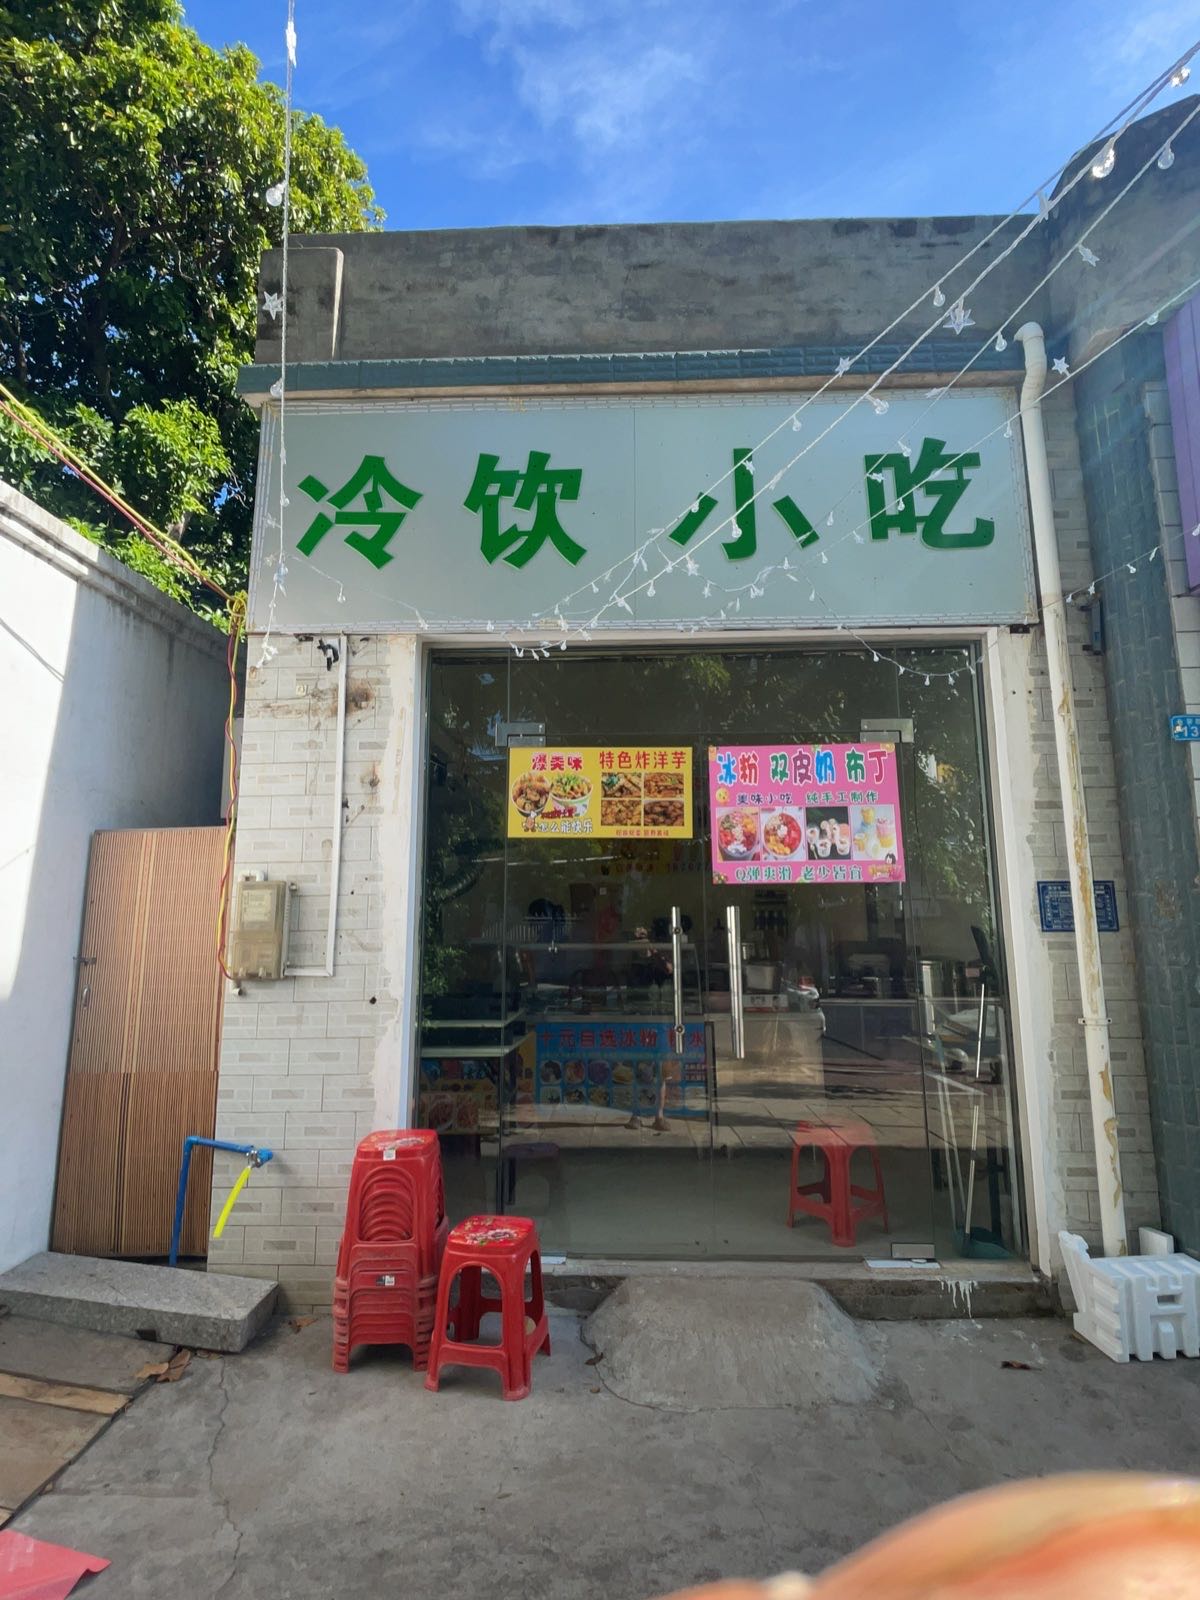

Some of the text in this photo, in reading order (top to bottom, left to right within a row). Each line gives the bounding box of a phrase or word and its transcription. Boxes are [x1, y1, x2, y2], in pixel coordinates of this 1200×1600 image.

[297, 437, 995, 570] 冷饮 小吃
[599, 750, 687, 770] 特色炸洋芋
[717, 747, 888, 786] 冰粉 双皮奶 布丁
[737, 792, 793, 805] 美味小吃
